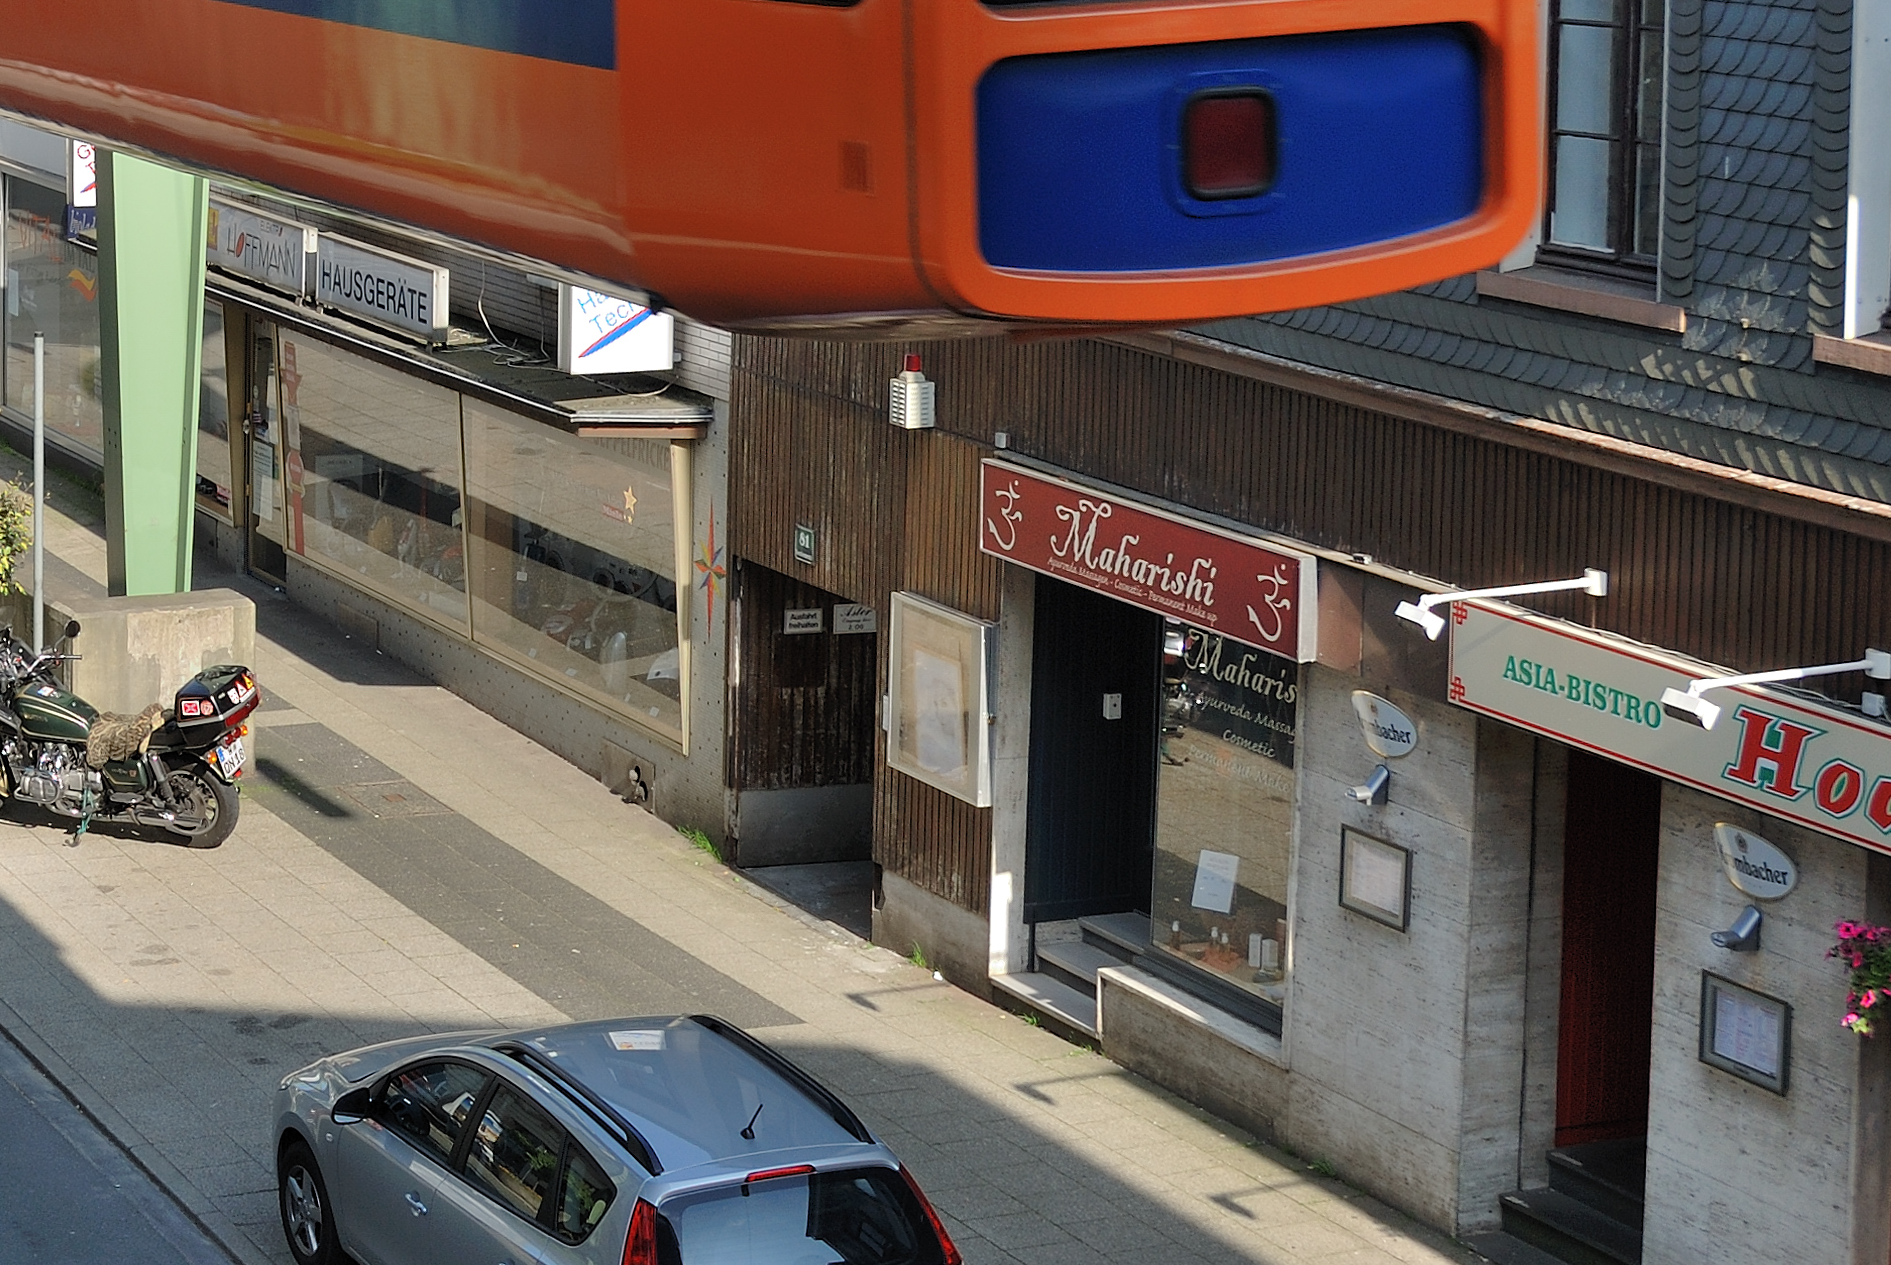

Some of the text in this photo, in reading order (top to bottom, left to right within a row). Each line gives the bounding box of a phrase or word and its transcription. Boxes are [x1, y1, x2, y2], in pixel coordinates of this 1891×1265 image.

[226, 223, 296, 279] HOFFMANN
[321, 259, 428, 325] HAUSGERÄTE
[1050, 499, 1217, 606] Maharishi
[1502, 654, 1662, 729] ASIA-BISTRO
[1222, 729, 1276, 758] Cosmetic
